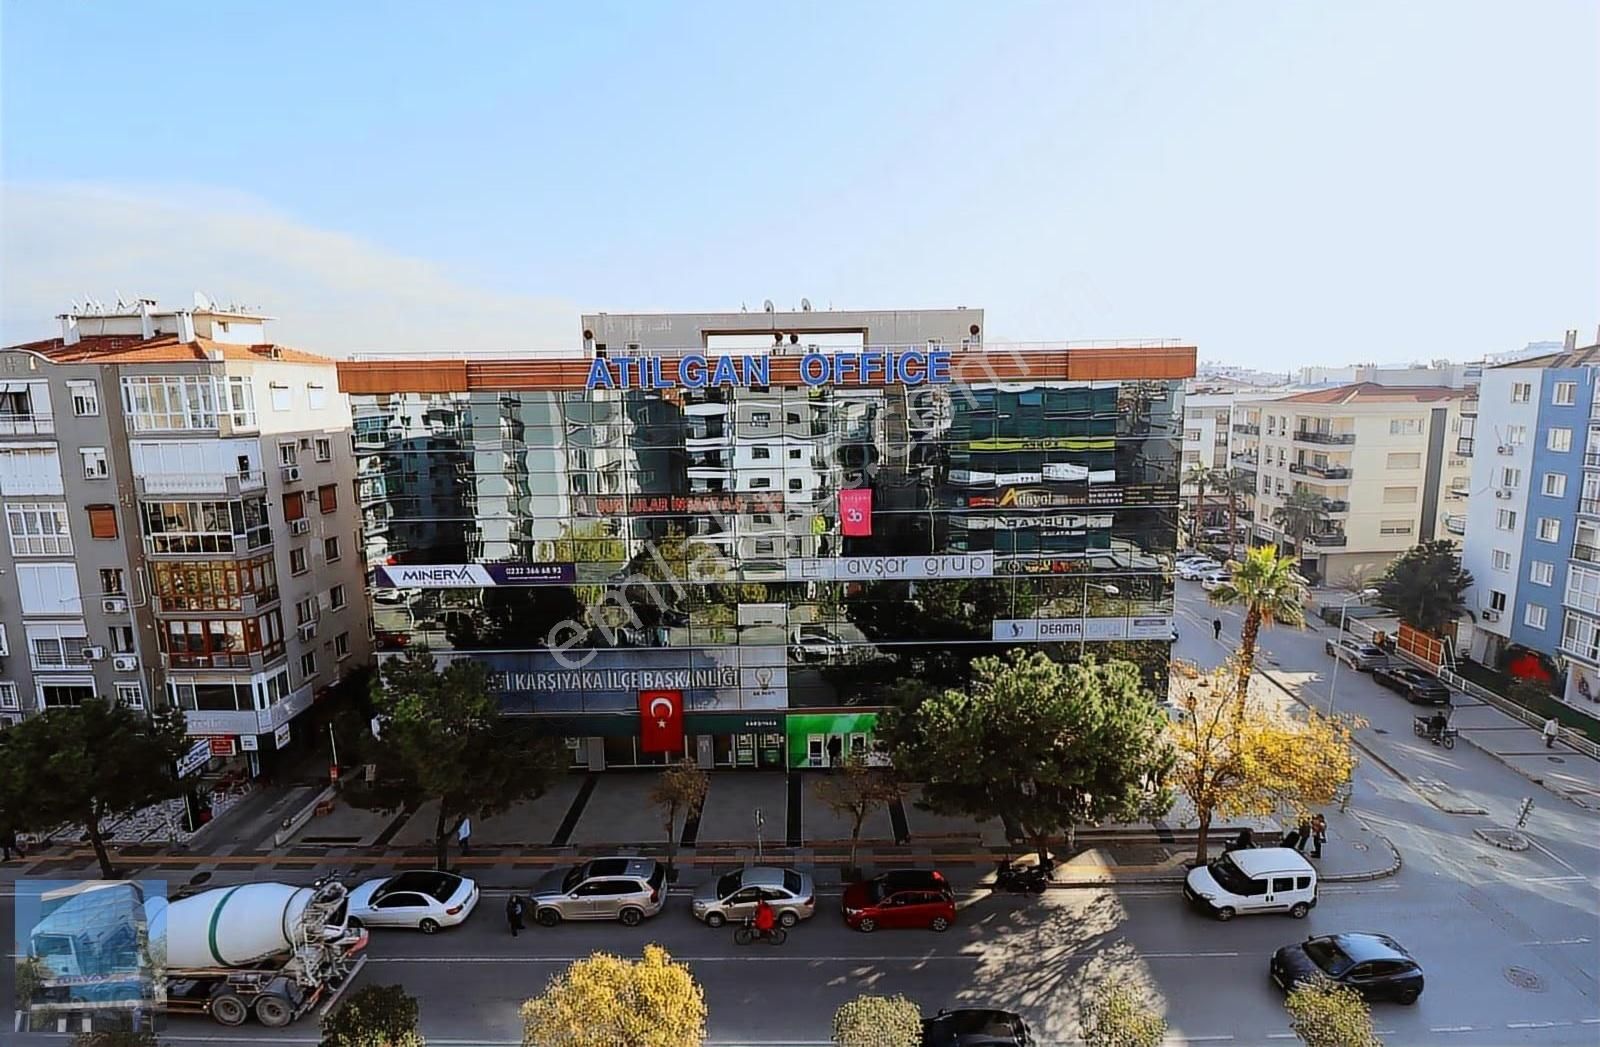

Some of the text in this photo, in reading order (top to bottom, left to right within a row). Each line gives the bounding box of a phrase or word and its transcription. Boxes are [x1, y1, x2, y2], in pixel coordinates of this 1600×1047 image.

[587, 350, 953, 389] ATILGAN OFFICE
[402, 565, 476, 584] MINERVA
[847, 554, 985, 581] avşar grup
[1040, 623, 1080, 636] DERMA
[515, 670, 603, 695] KARŞIYAKA
[606, 669, 639, 693] İLÇE
[643, 668, 741, 690] BAŞKANLIĞI
